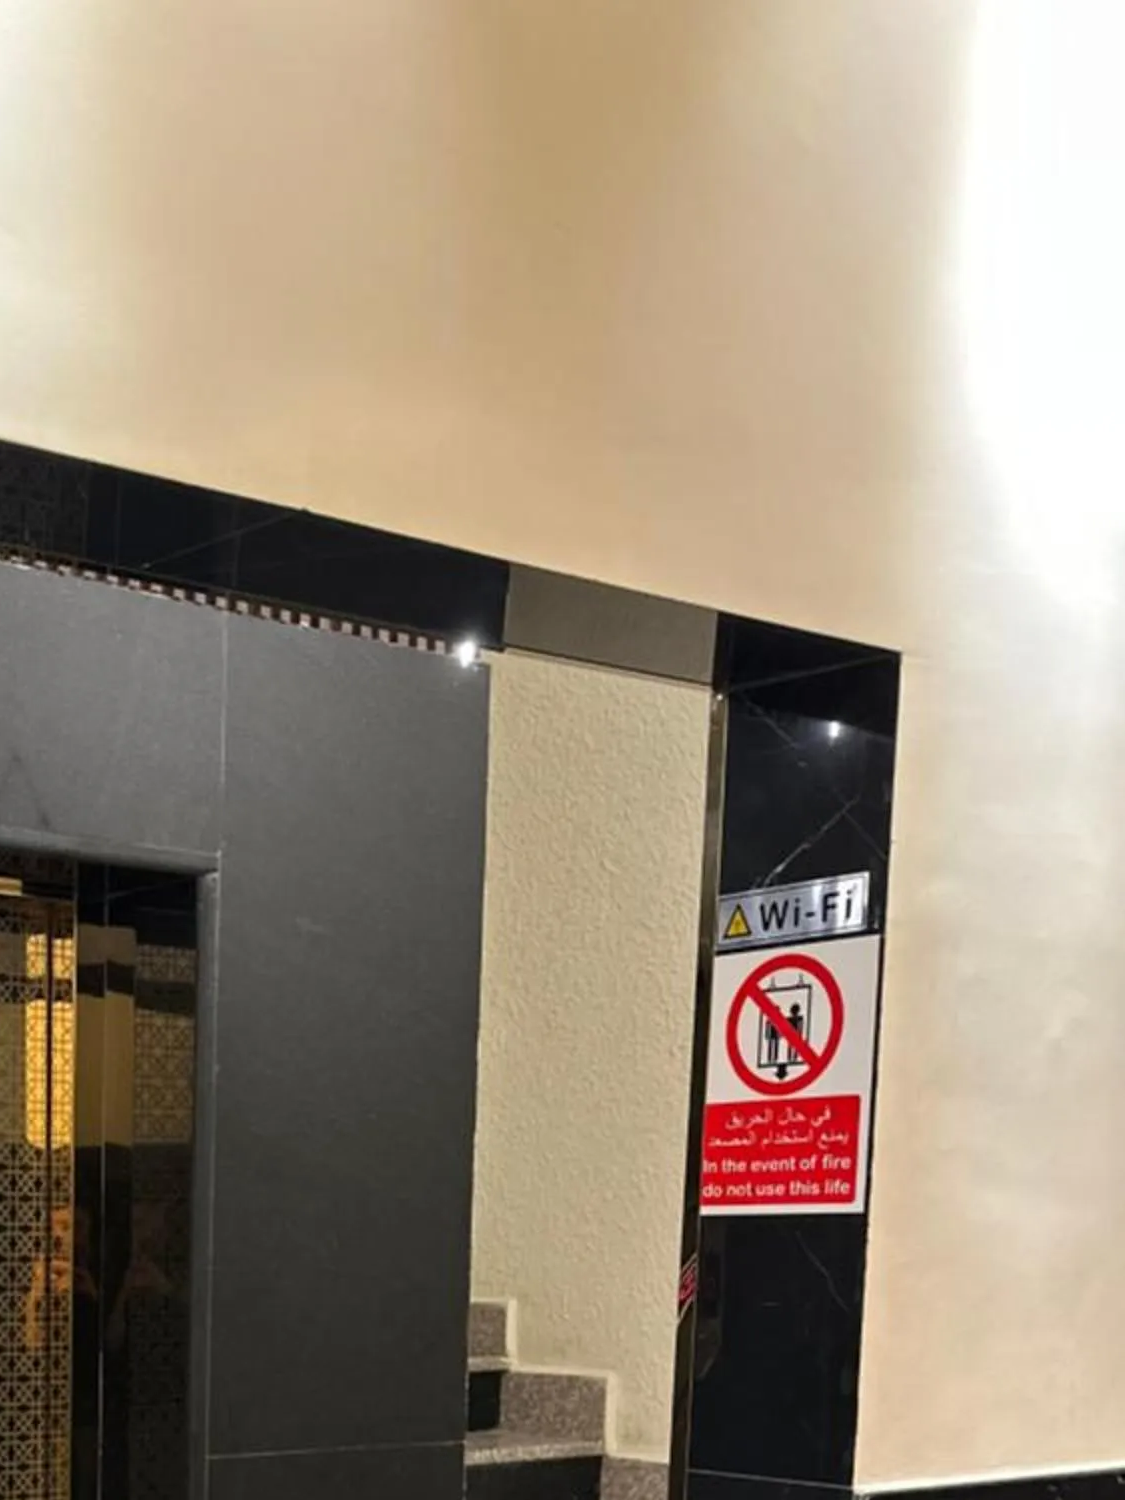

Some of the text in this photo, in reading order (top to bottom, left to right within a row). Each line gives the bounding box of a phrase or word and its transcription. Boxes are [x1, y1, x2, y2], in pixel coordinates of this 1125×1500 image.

[759, 889, 854, 931] Wi-Fi
[725, 1104, 832, 1130] في حال الحريق
[708, 1129, 850, 1150] يمنع استخدام المصعد
[702, 1153, 852, 1173] In the event of fire
[702, 1181, 723, 1198] do
[726, 1181, 753, 1197] not
[755, 1182, 786, 1197] use
[789, 1179, 820, 1196] this
